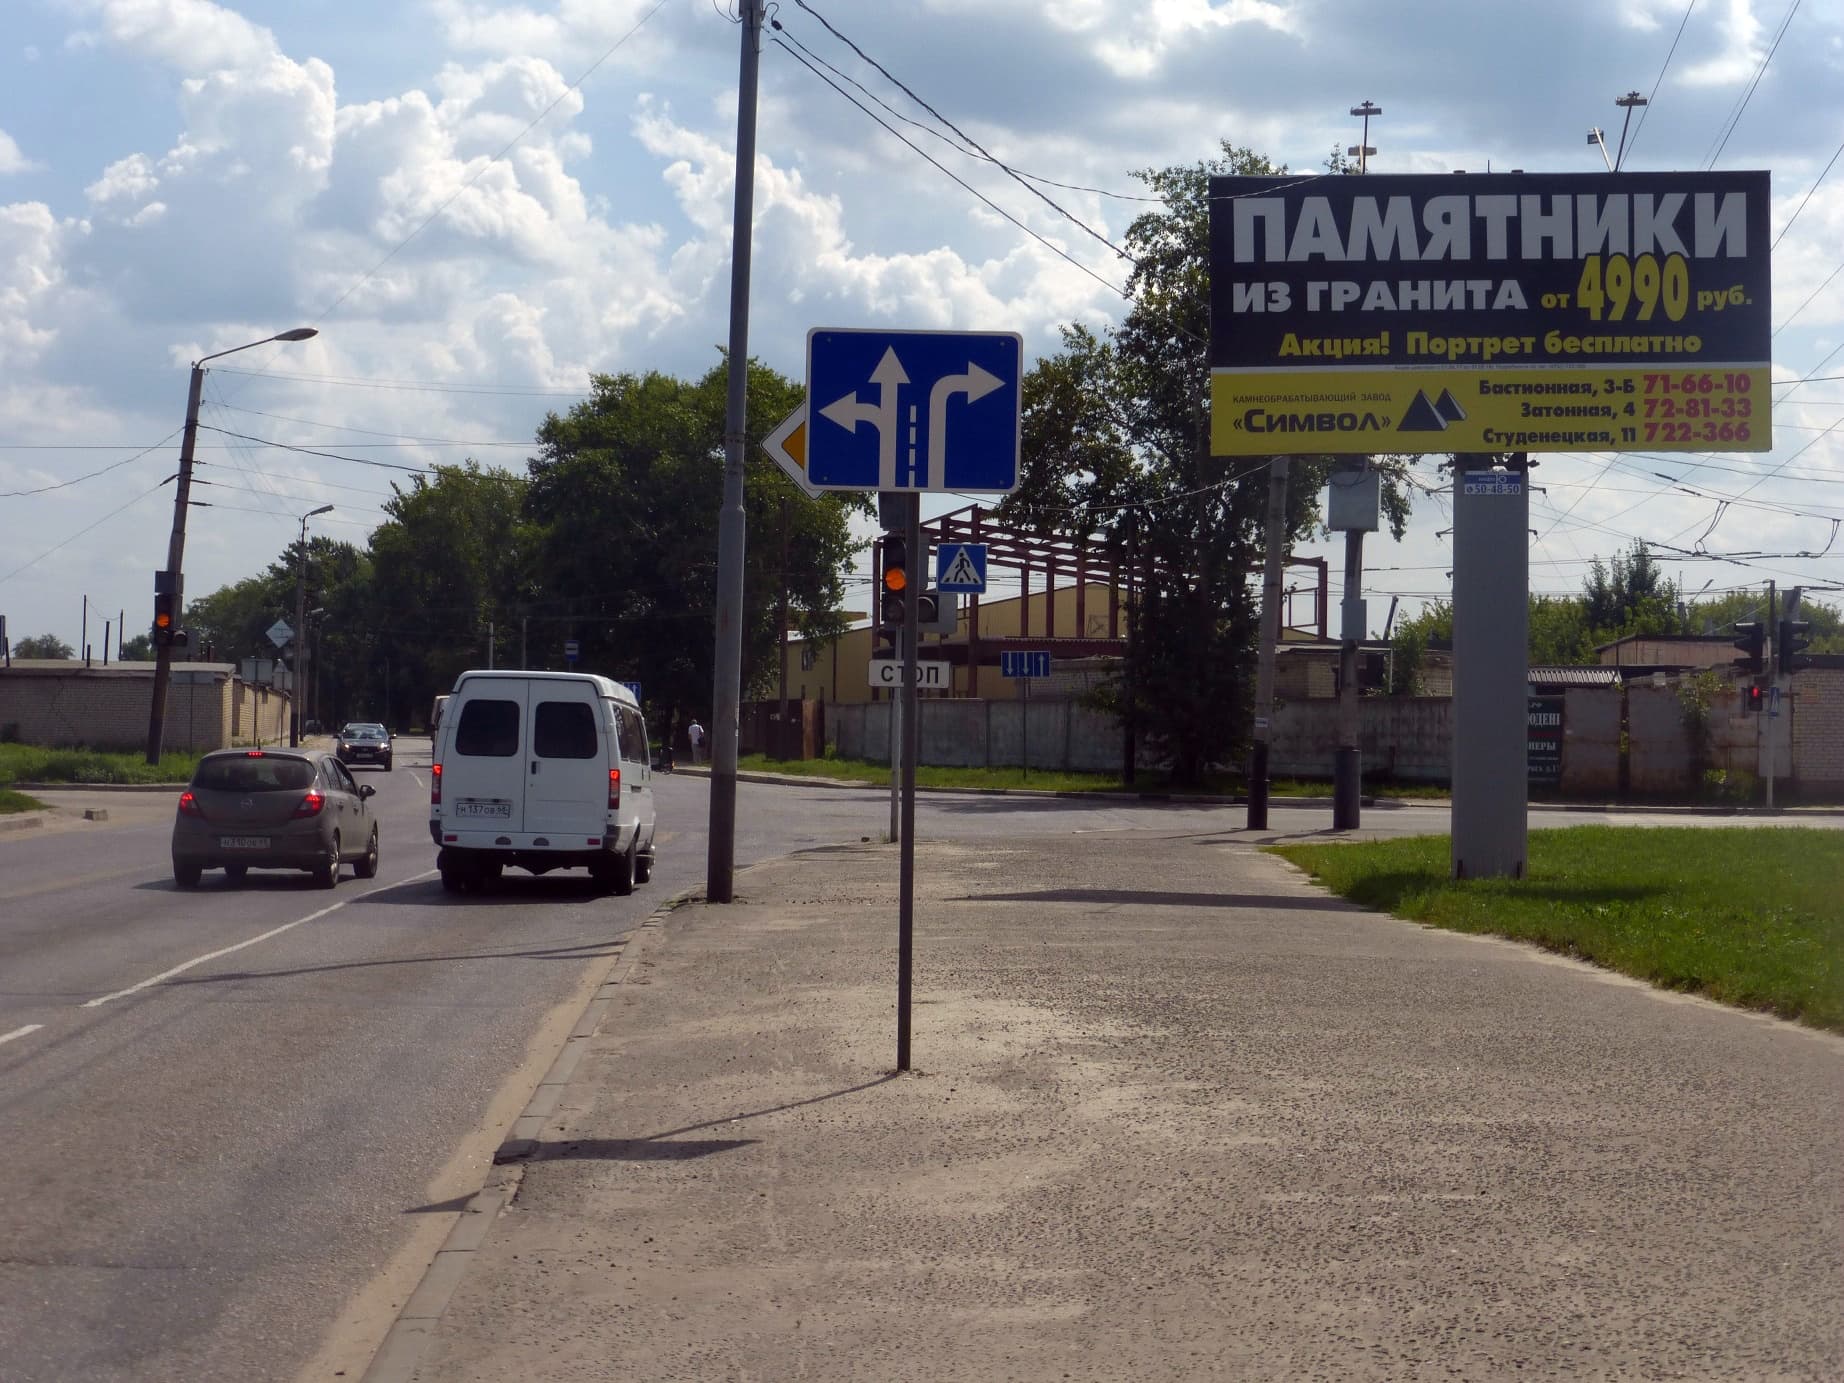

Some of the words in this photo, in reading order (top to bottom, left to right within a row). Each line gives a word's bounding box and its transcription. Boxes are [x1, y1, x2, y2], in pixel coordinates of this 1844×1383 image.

[1233, 192, 1747, 262] ПАМЯТНИКИ
[1232, 281, 1292, 313] ИЗ
[1306, 279, 1528, 313] ГРАНИТА
[1540, 292, 1571, 309] от
[1577, 252, 1689, 322] 4990
[1697, 286, 1752, 312] руб.
[1278, 331, 1391, 360] Акция!
[1406, 331, 1536, 360] Портрет
[1544, 329, 1702, 354] бесплатно
[1232, 393, 1357, 404] КАМНЕОБРАБАТЫВАЮЩИЙ
[1360, 392, 1392, 402] ЗАВОД
[1479, 379, 1599, 398] Бастионная,
[1603, 378, 1636, 395] 3-Б
[1642, 374, 1752, 395] 71-66-10
[1520, 402, 1618, 421] Затонная,
[1622, 402, 1636, 417] 4
[1642, 398, 1752, 419] 72-81-33
[1482, 427, 1617, 448] Студенецкая,
[1620, 426, 1637, 443] 11
[1642, 422, 1751, 443] 722-366
[1474, 484, 1520, 494] 50-48-50
[880, 665, 939, 684] СТОП
